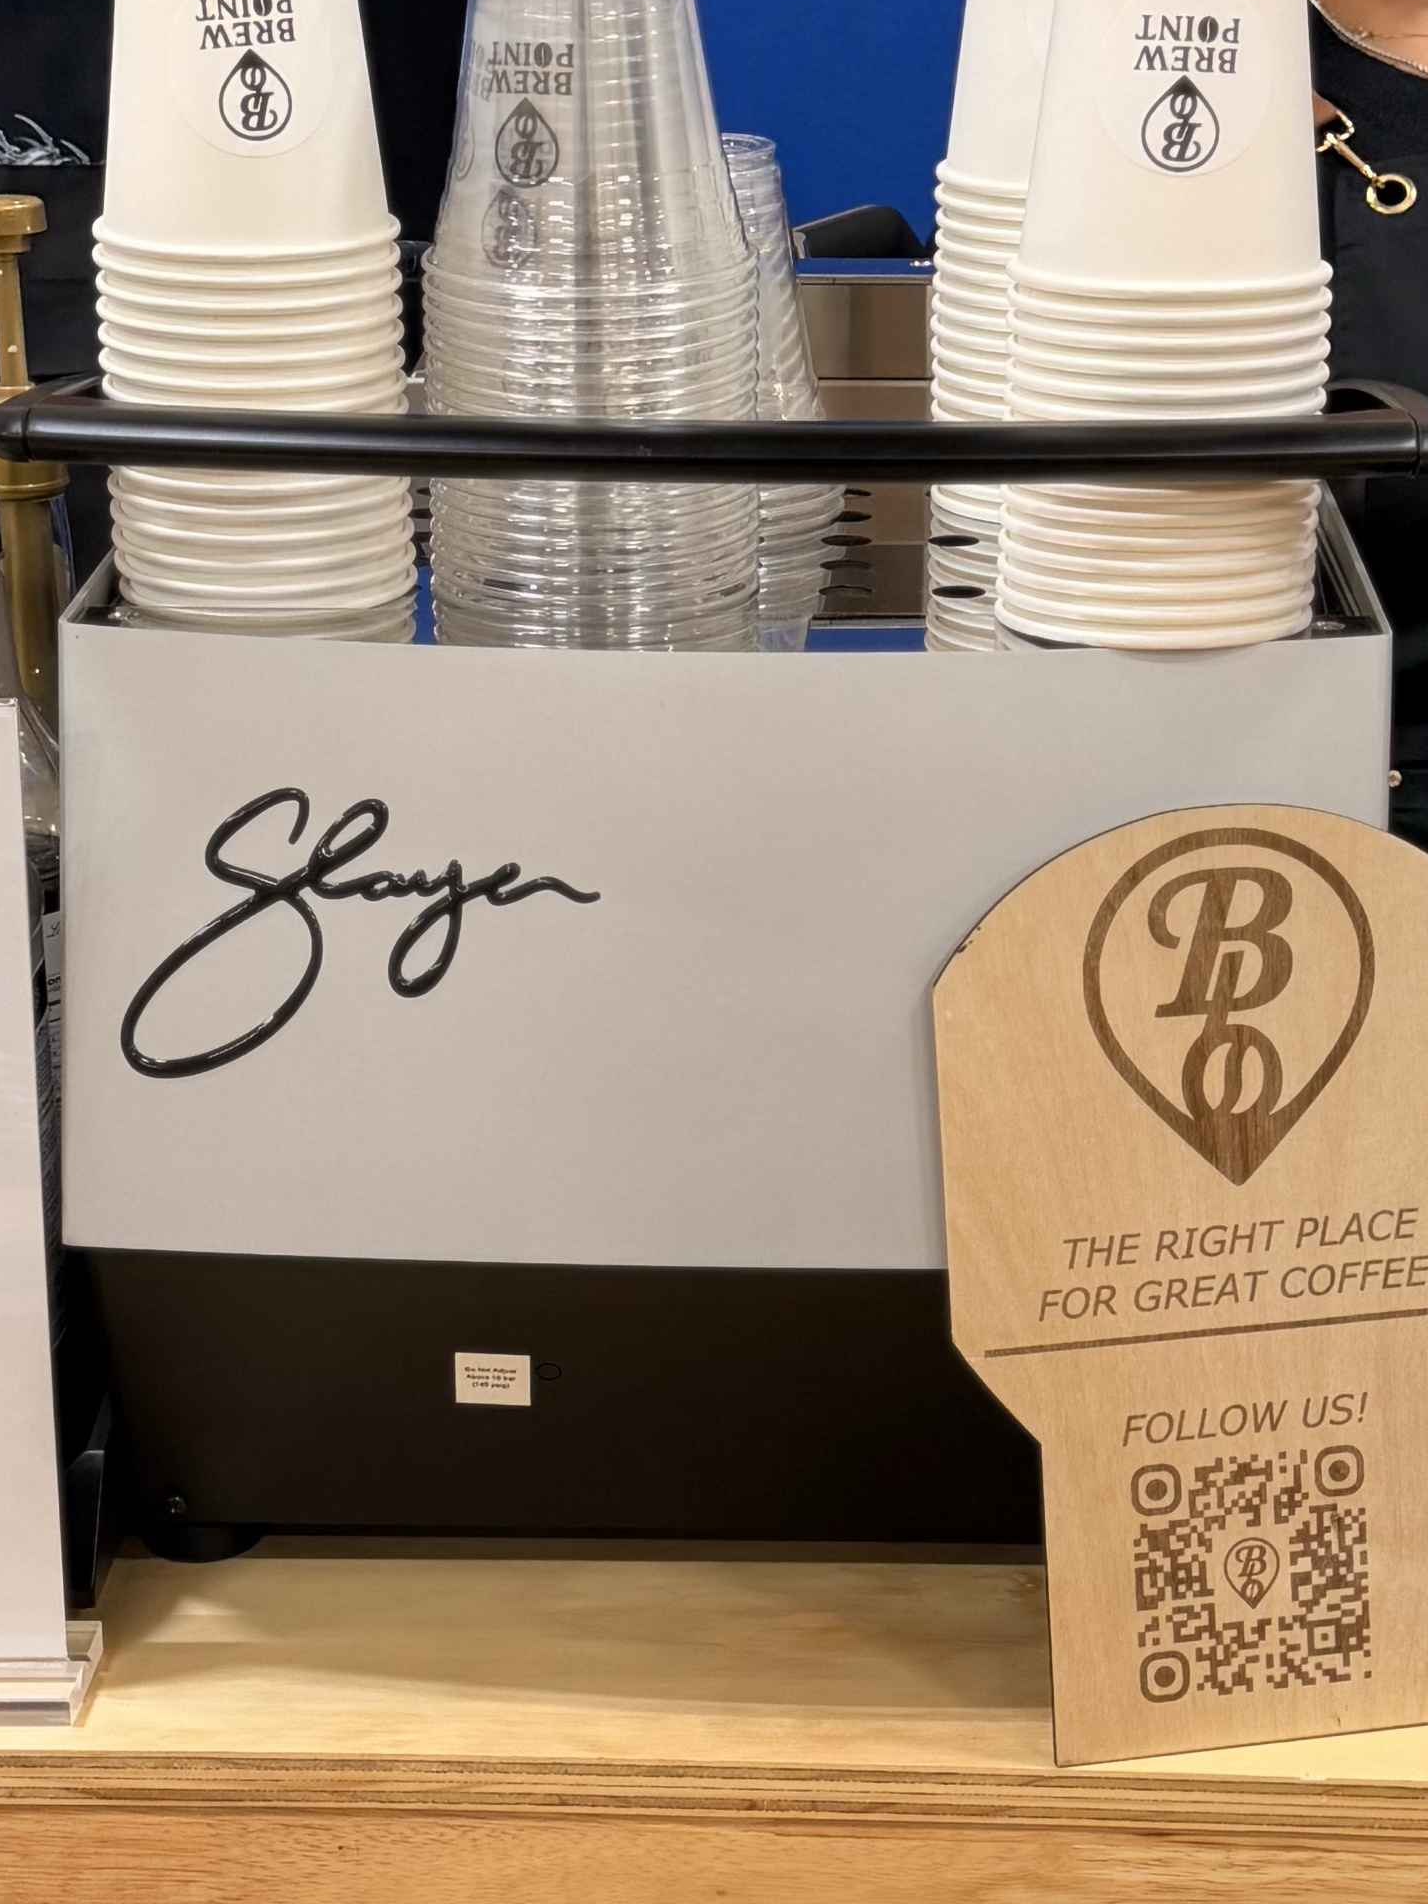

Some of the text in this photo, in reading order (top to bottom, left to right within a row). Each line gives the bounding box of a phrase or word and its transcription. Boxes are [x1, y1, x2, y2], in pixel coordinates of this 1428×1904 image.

[195, 16, 296, 52] BREW
[1134, 14, 1241, 44] POINT
[489, 41, 575, 69] POINT
[1133, 40, 1240, 74] BREW
[488, 69, 574, 96] BREW
[1062, 1207, 1419, 1270] THE RIGHT PLACE
[1038, 1284, 1118, 1323] FOR
[1133, 1272, 1268, 1313] GREAT
[1122, 1391, 1368, 1448] FOLLOW US!
